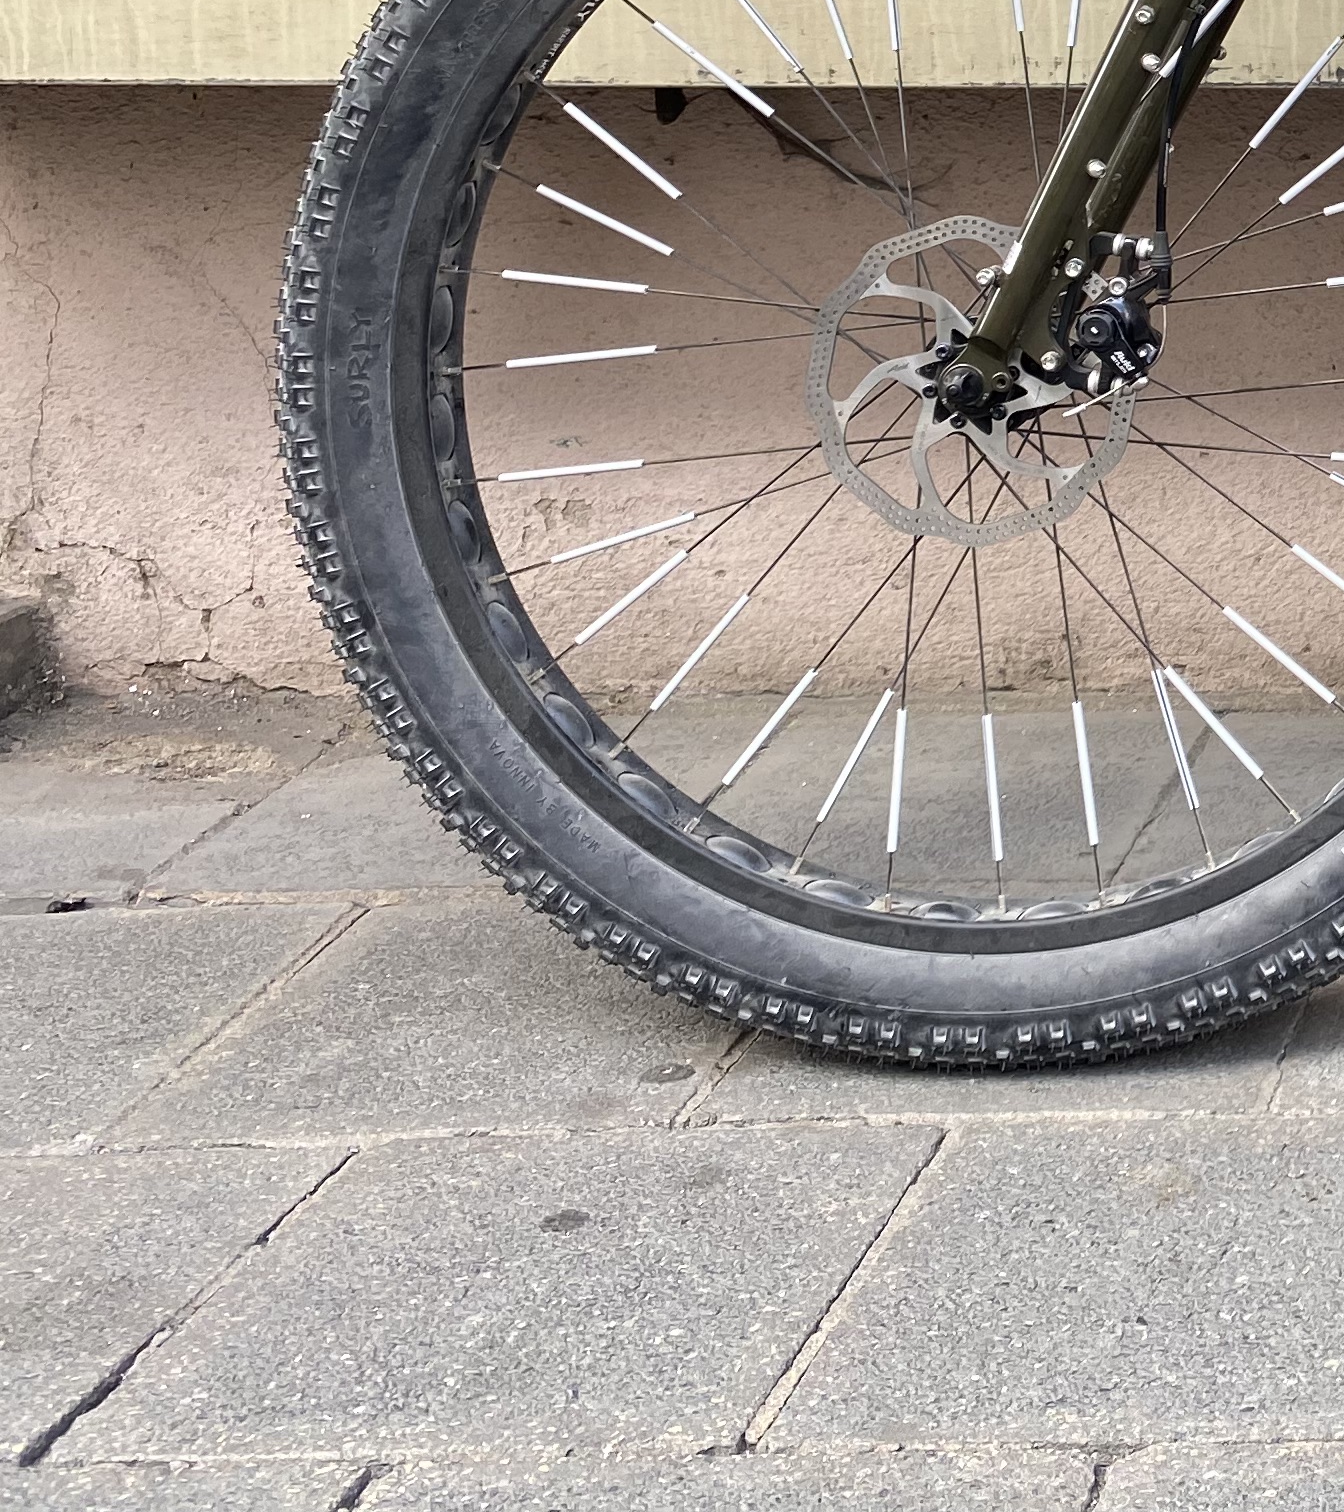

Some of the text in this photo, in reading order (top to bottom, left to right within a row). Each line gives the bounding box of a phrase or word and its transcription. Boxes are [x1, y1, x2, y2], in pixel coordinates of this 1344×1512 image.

[346, 306, 382, 429] SURLY
[489, 739, 602, 854] MADE BY INNOVA
